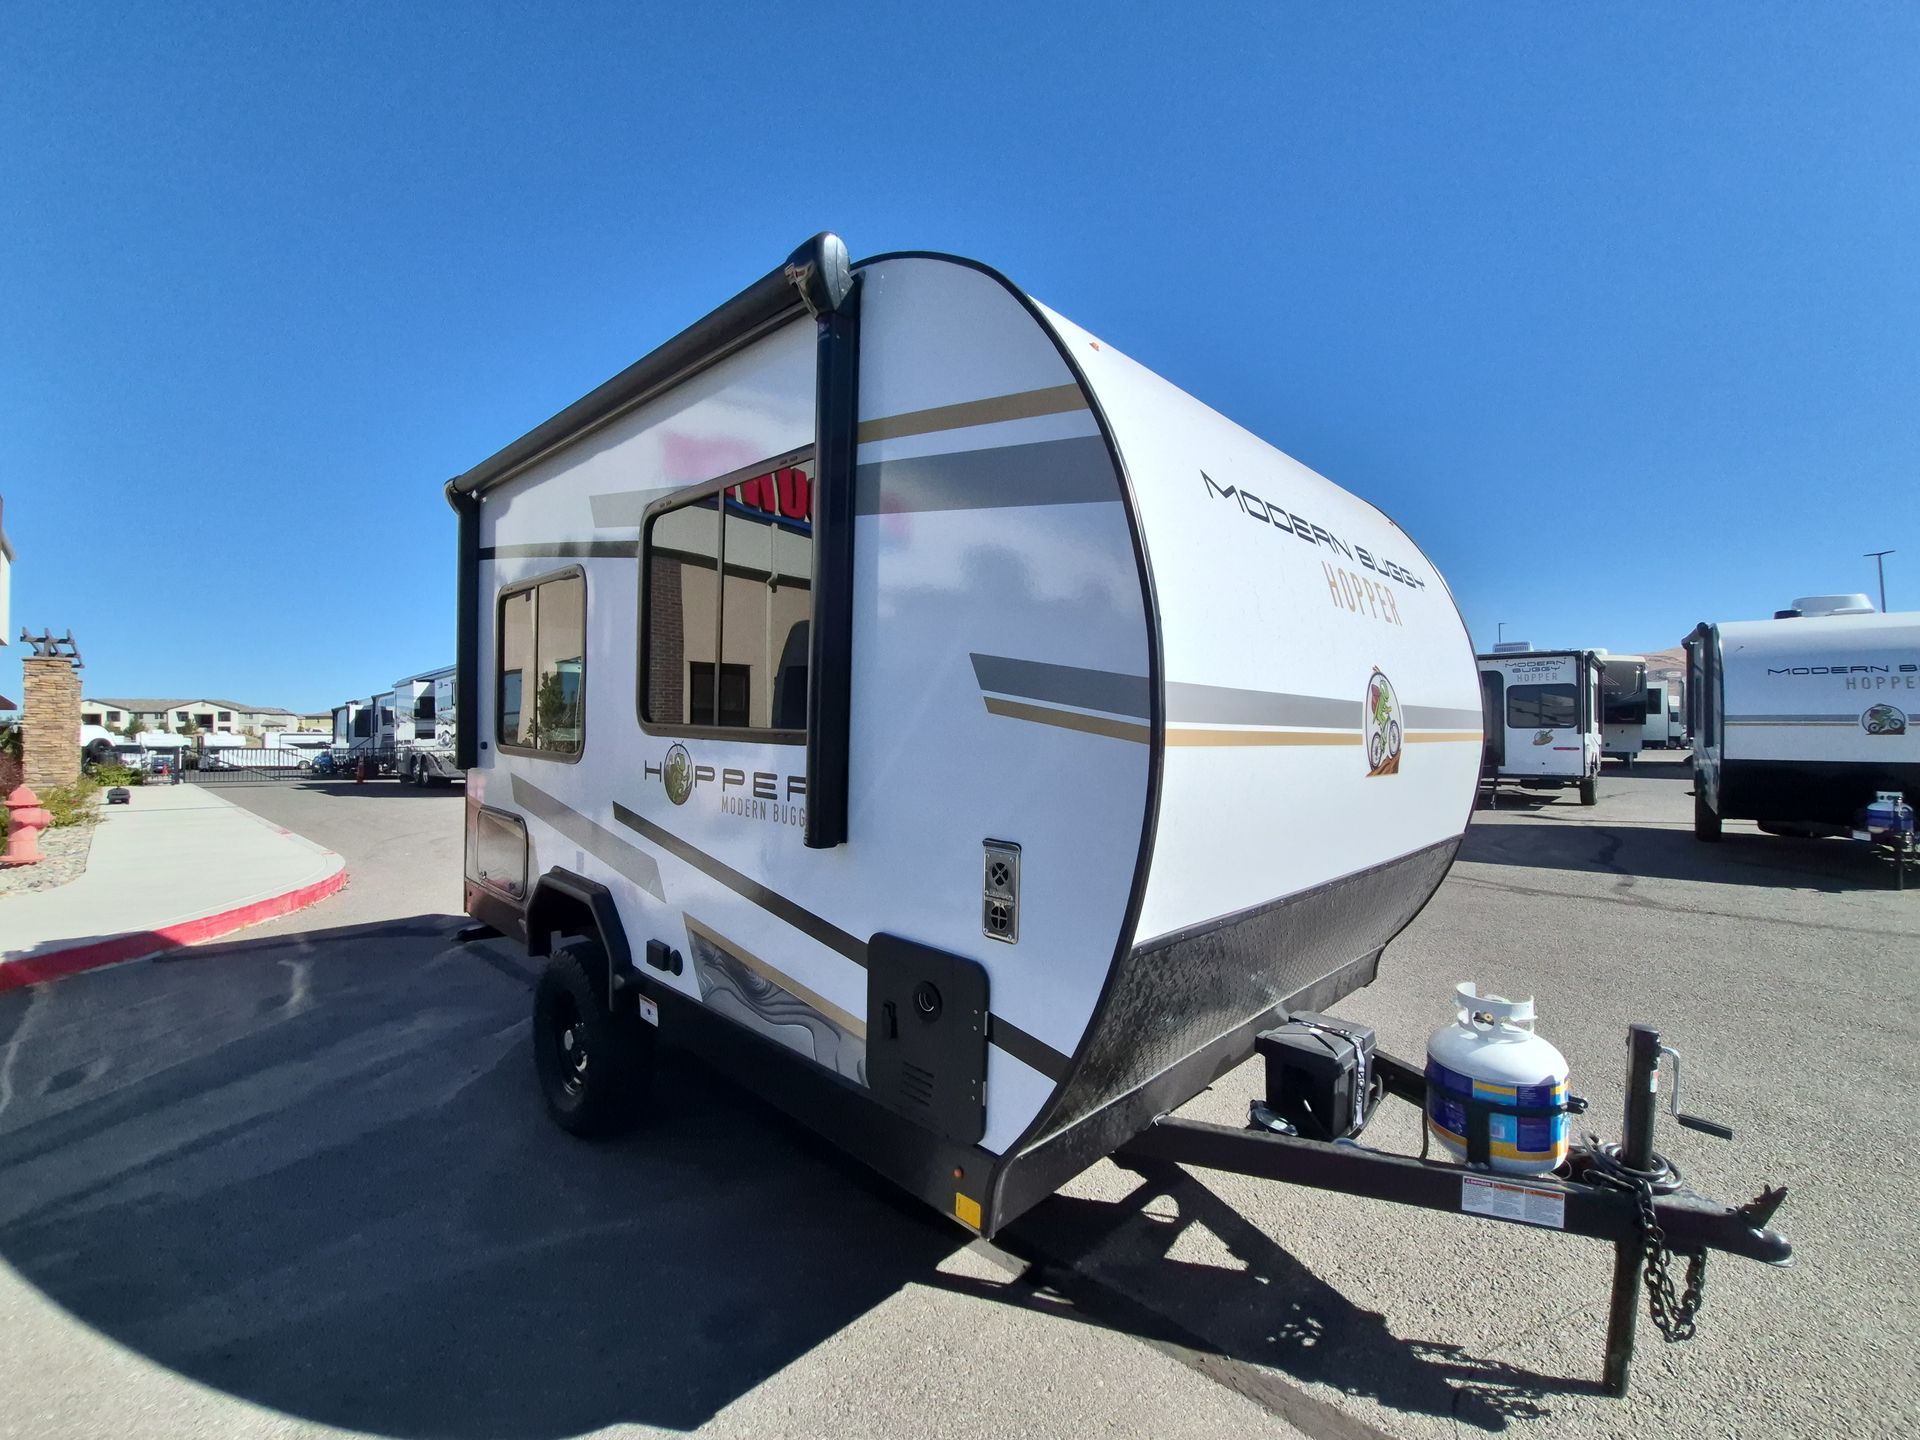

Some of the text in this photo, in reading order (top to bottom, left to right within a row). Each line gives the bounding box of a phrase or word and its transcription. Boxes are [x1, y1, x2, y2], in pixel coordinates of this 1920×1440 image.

[1199, 468, 1426, 592] MODERN BUGGY
[1321, 560, 1403, 627] HOPPER
[1517, 672, 1557, 681] HOPPER
[1767, 664, 1889, 676] MODERN
[1846, 676, 1920, 690] HOPPE
[721, 796, 767, 821] MODERN
